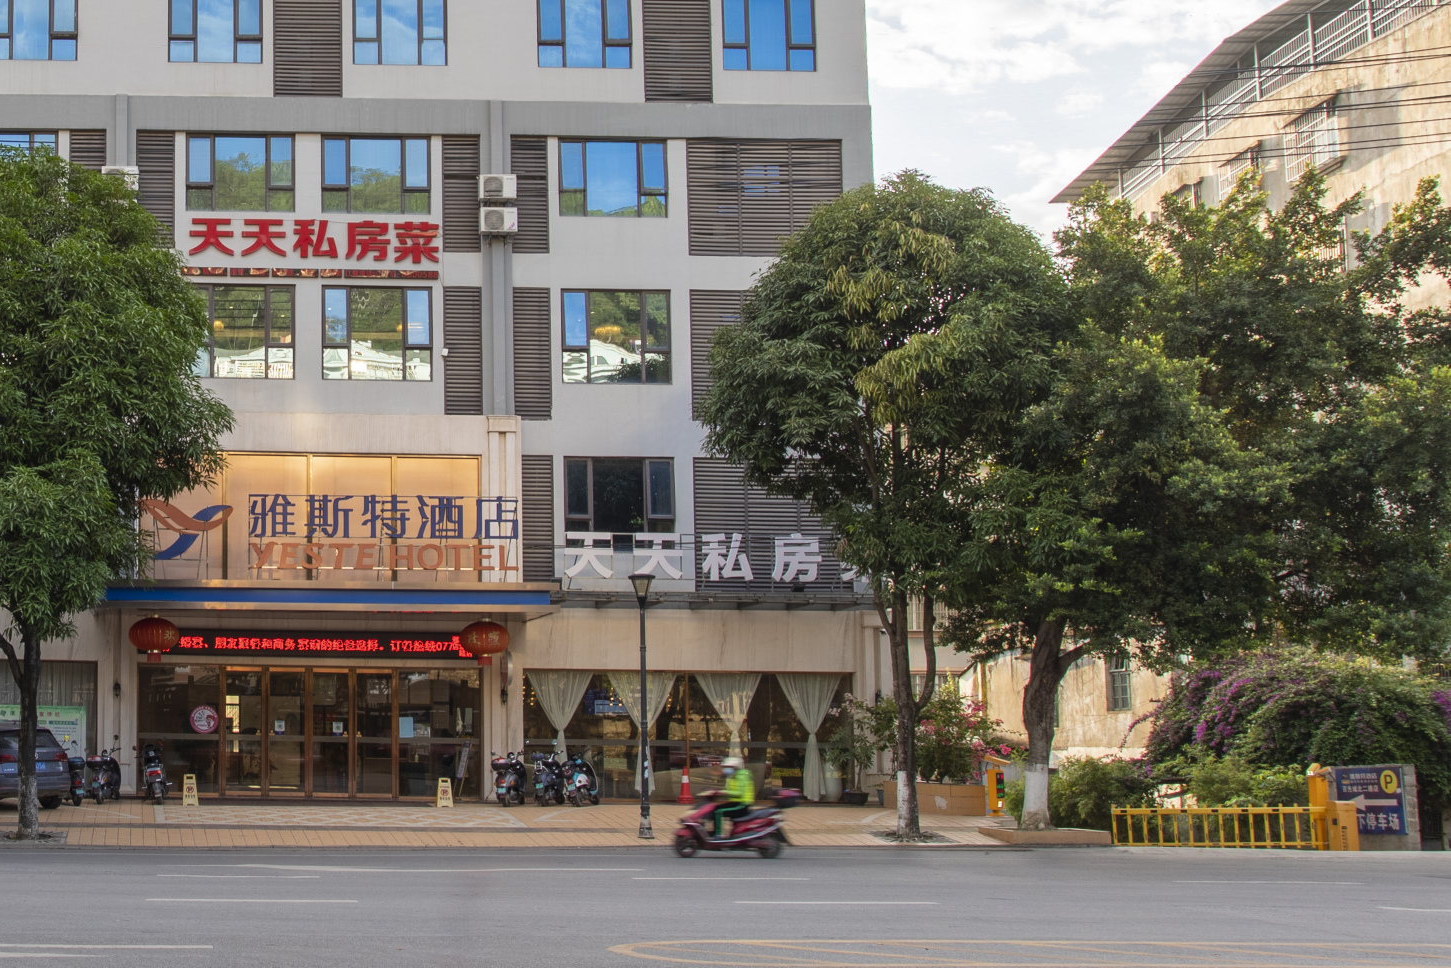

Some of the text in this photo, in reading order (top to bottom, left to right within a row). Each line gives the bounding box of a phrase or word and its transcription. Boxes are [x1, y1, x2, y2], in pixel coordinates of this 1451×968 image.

[189, 218, 440, 264] 天天私房菜
[249, 494, 519, 540] 雅斯特酒店
[250, 542, 519, 571] YESTE HOTEL
[564, 532, 872, 583] 天天私房
[1356, 812, 1400, 831] 下停车场
